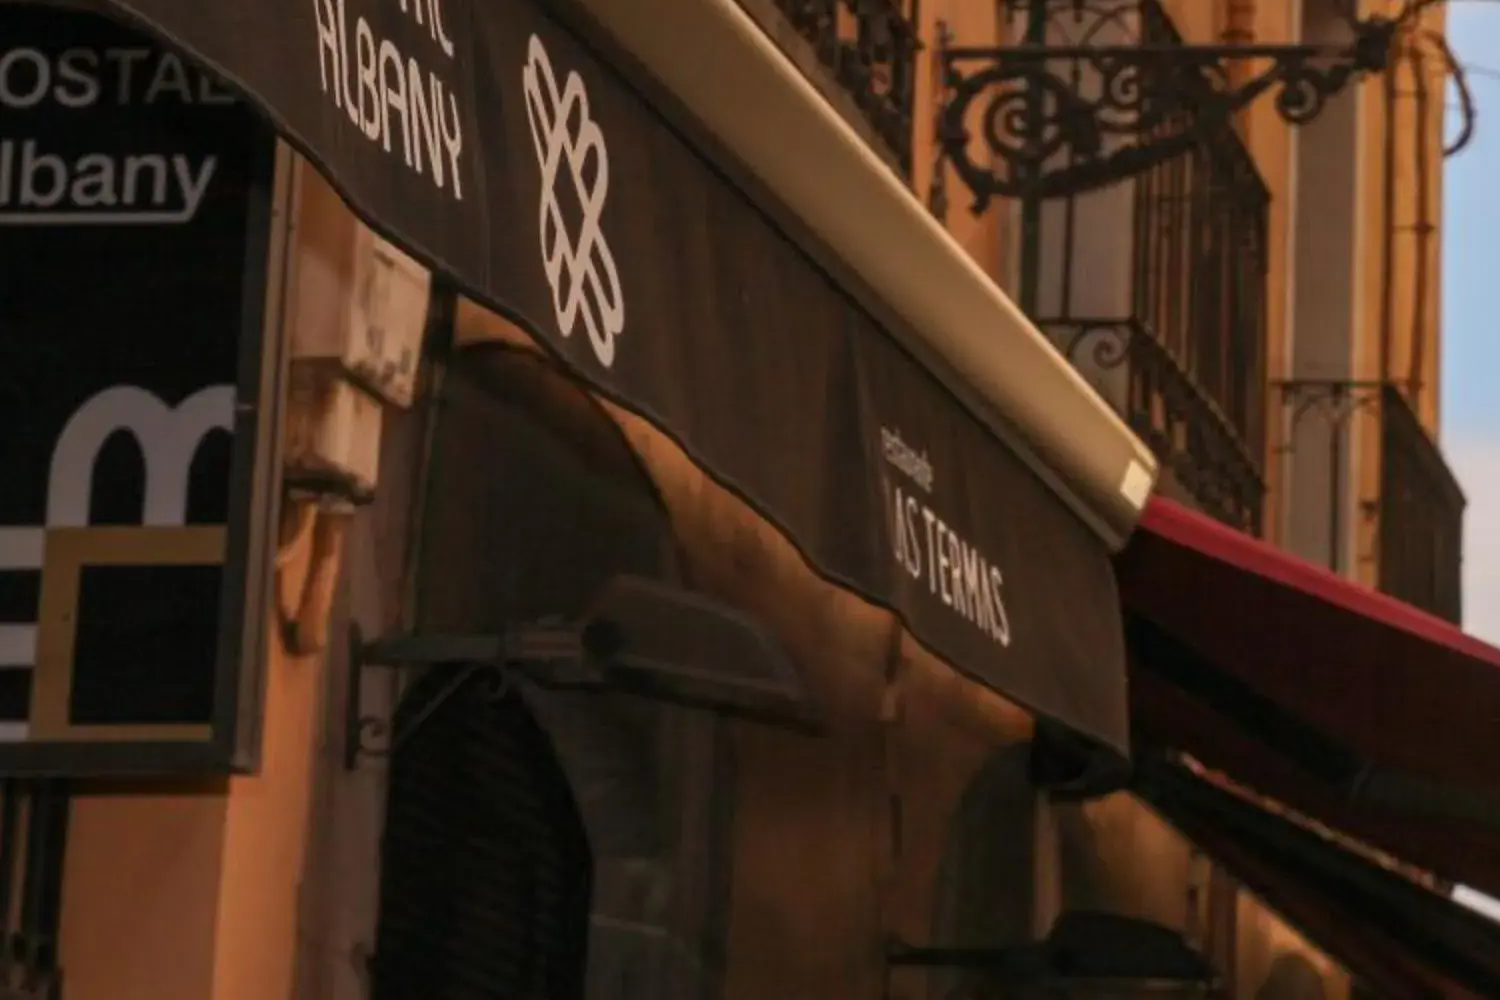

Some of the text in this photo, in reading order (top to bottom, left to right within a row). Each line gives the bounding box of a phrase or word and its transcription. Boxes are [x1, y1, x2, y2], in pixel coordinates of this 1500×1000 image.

[0, 47, 237, 108] OSTAL
[0, 138, 218, 224] lbany
[921, 504, 1011, 647] TERMAS
